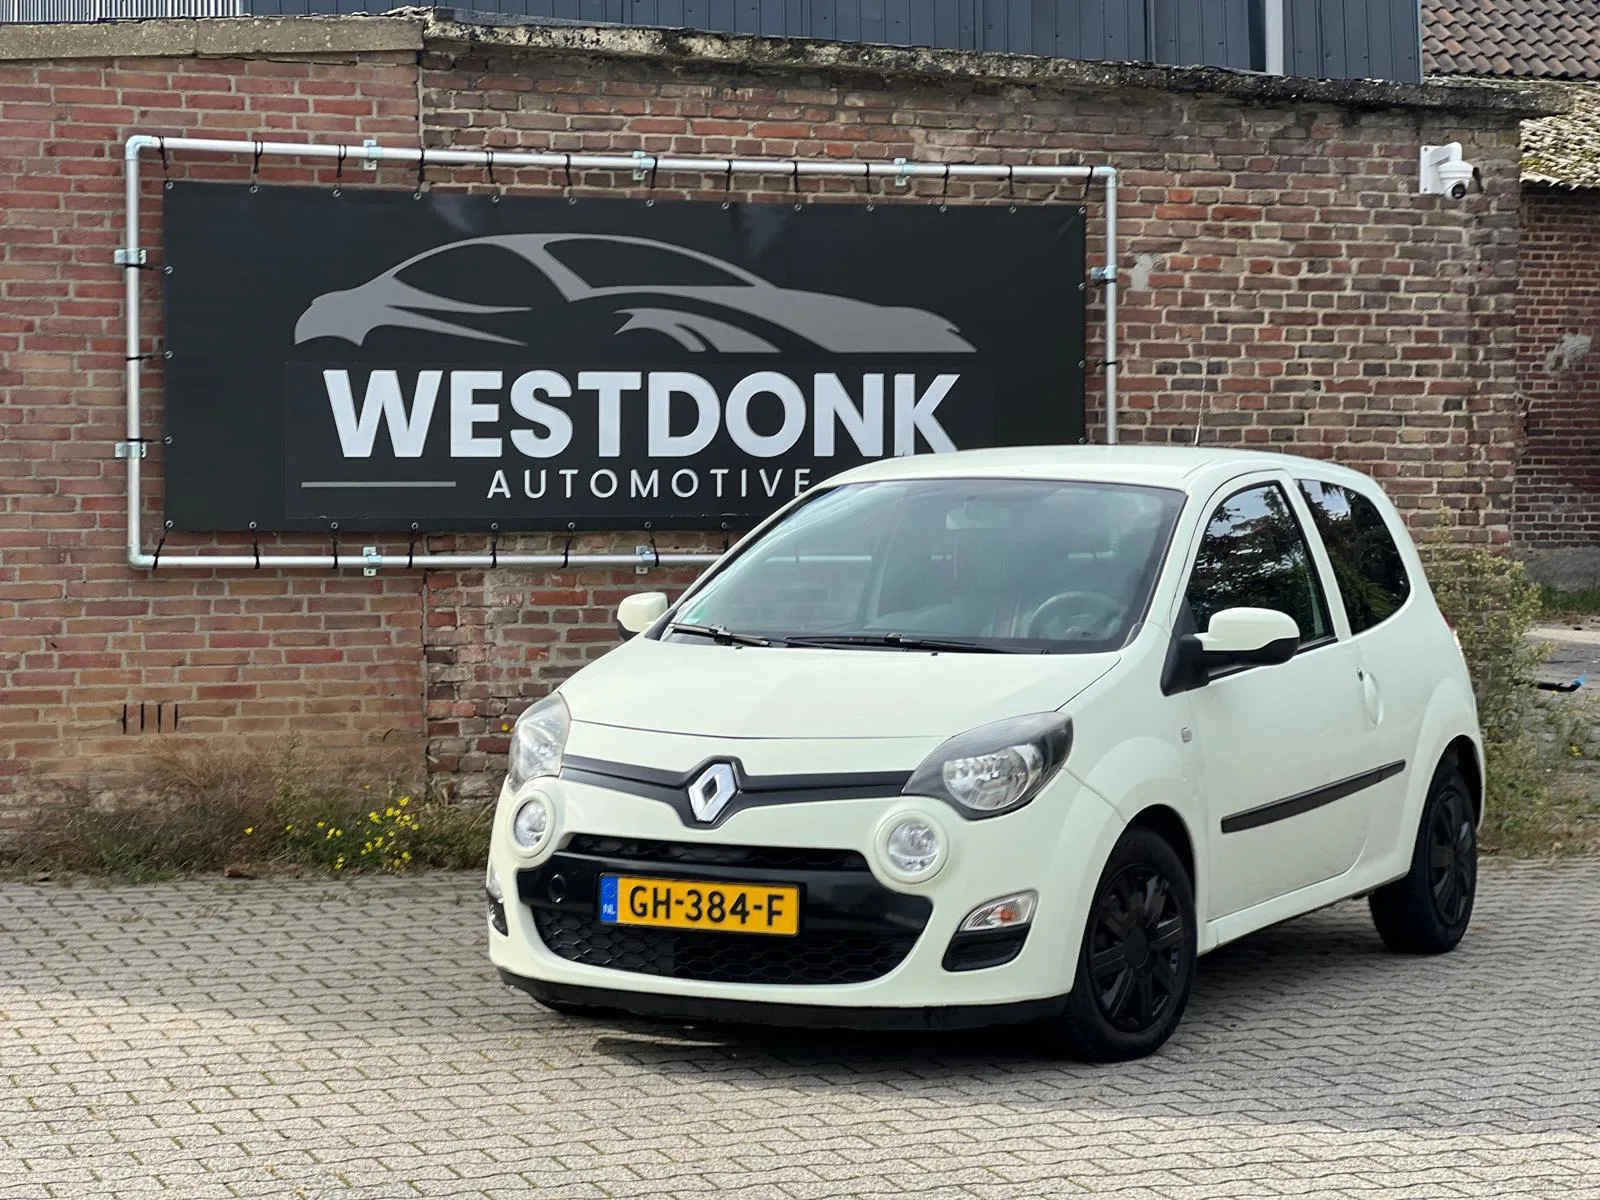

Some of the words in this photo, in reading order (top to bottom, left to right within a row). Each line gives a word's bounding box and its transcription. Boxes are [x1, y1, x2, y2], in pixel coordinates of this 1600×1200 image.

[323, 369, 960, 458] WESTDONK
[486, 467, 812, 499] AUTOMOTIVE
[602, 902, 616, 916] NL
[629, 885, 784, 927] GH-384-F
